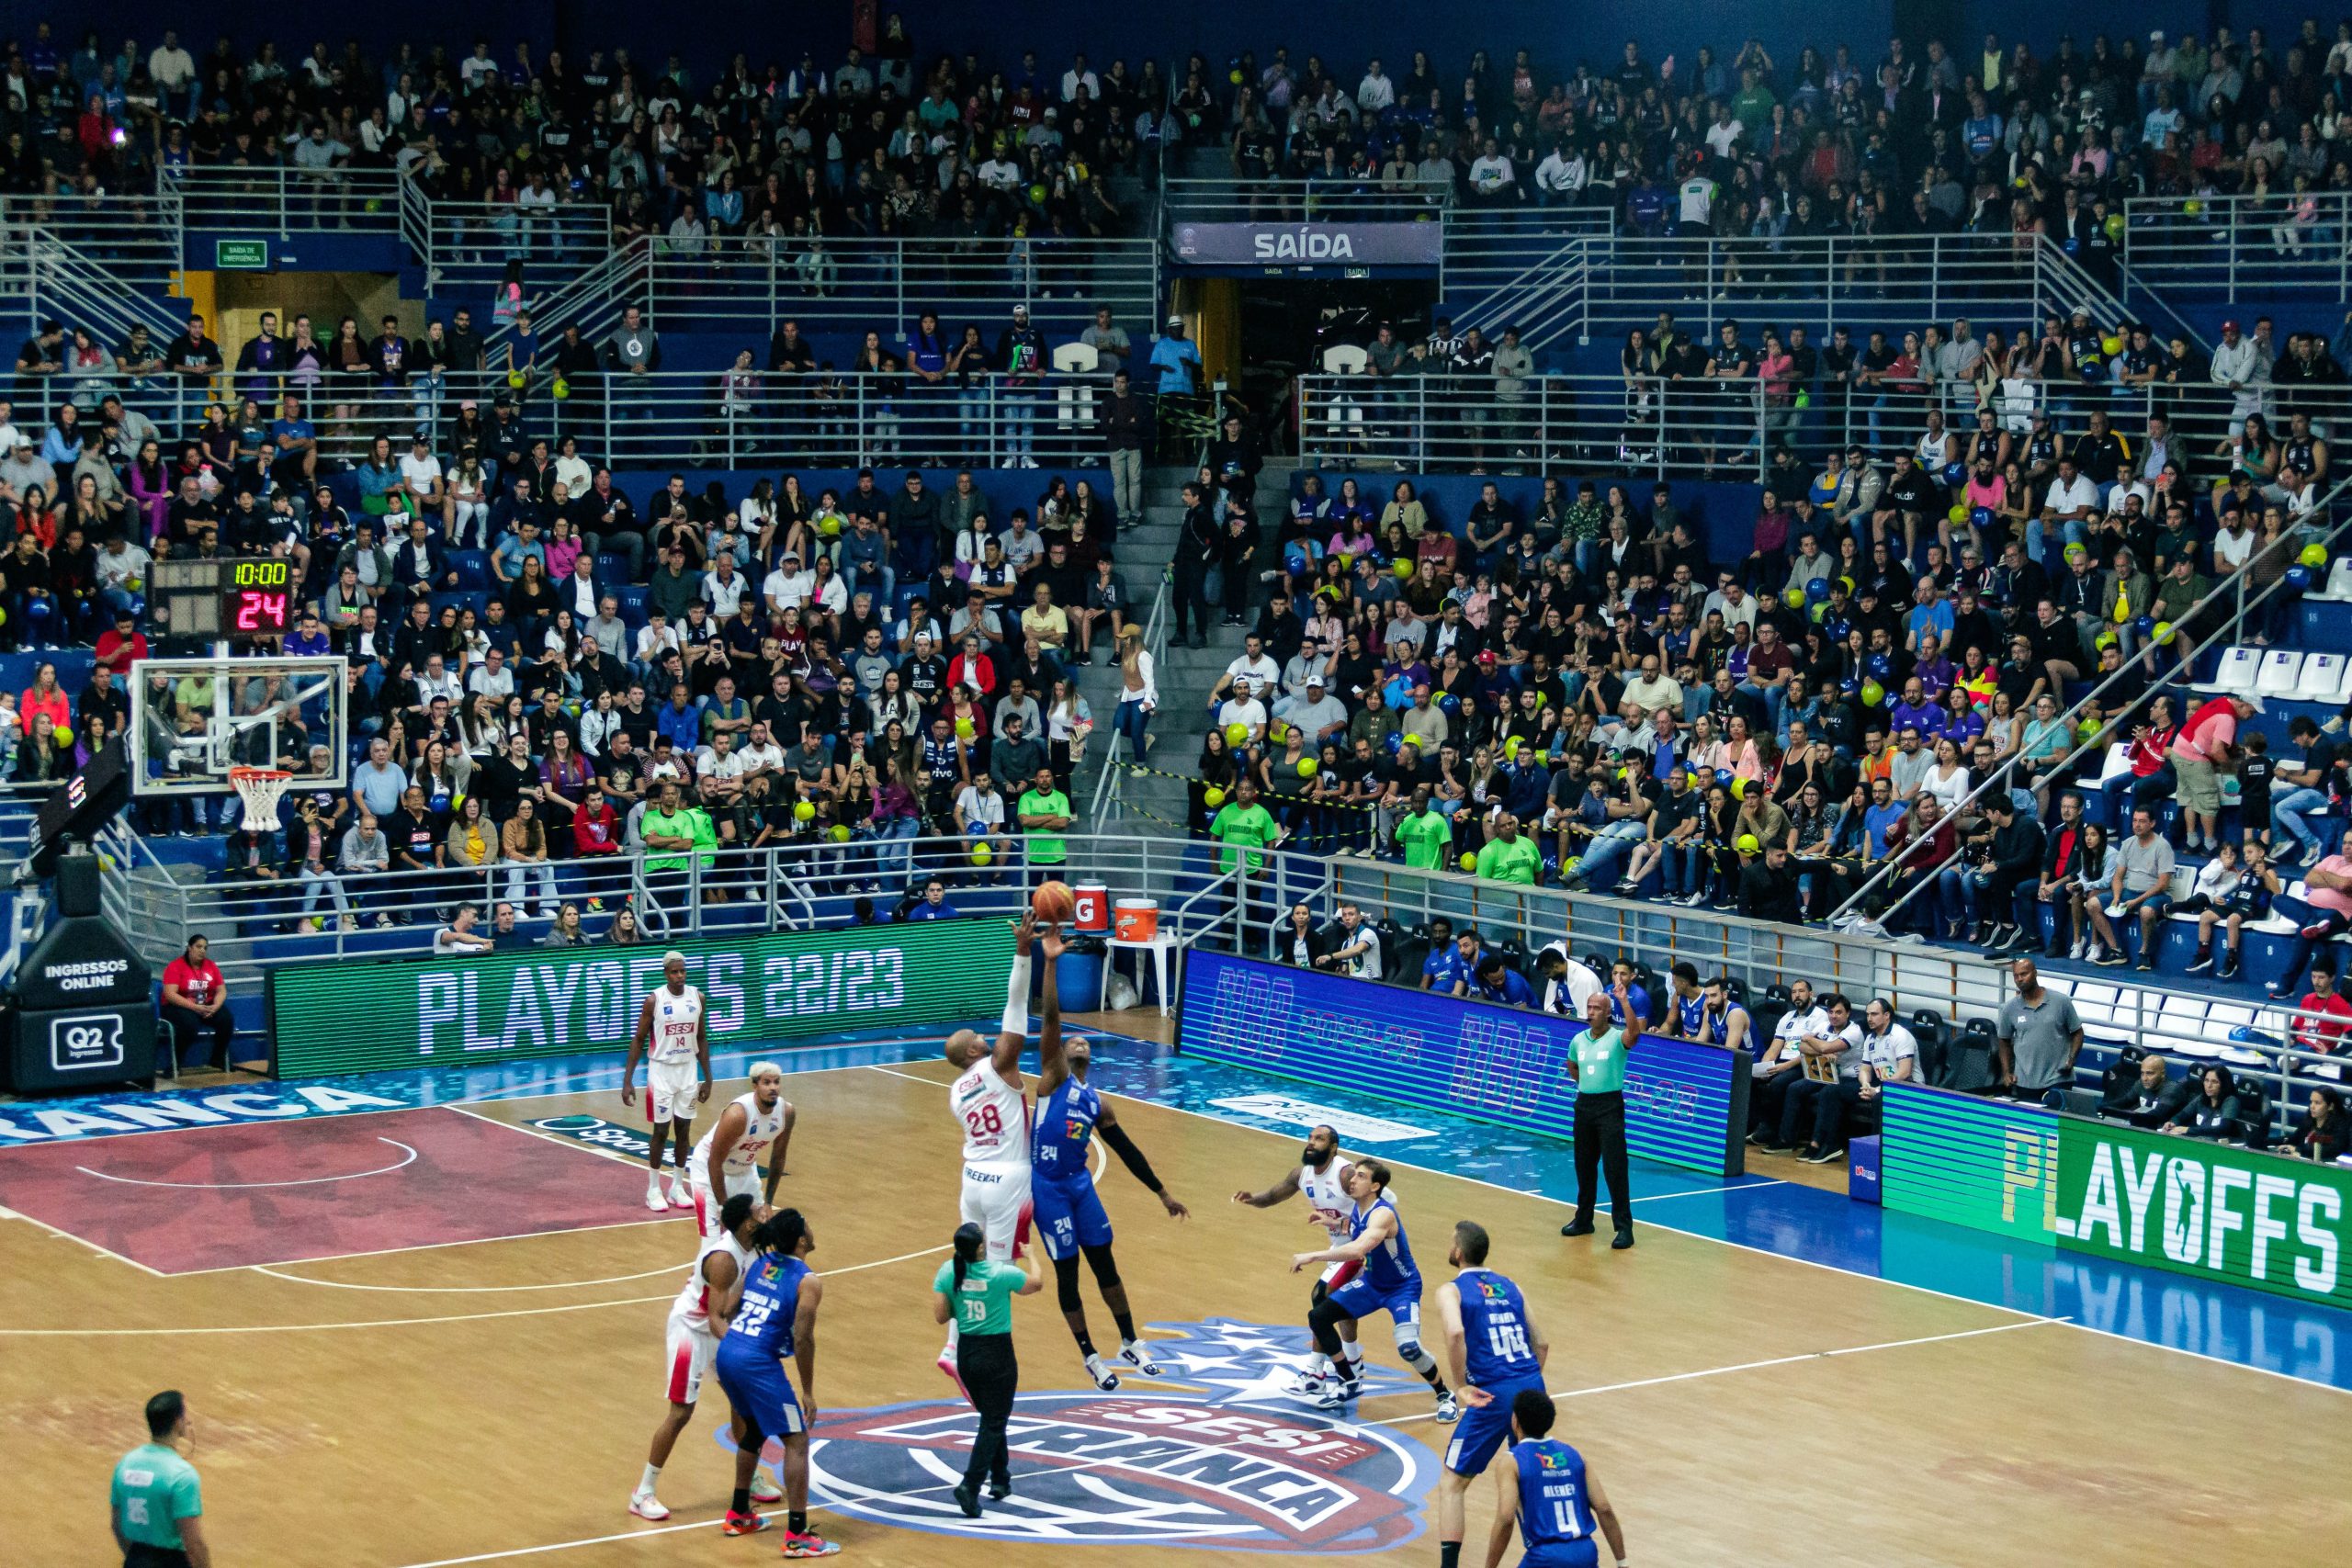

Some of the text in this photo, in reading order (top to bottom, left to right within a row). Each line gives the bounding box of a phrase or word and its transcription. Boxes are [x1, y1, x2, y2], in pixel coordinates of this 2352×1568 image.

[1255, 227, 1353, 258] SAÍDA
[235, 563, 286, 585] 10:00
[238, 591, 286, 628] 24
[2120, 806, 2130, 815] 14
[2164, 811, 2173, 820] 13
[1076, 897, 1093, 922] G
[2128, 927, 2137, 937] 11
[2171, 933, 2182, 943] 10
[2267, 945, 2273, 955] 8
[45, 960, 128, 978] INGRESSOS
[61, 975, 115, 990] ONLINE
[418, 947, 905, 1055] PLAYOFS 22/23
[67, 1027, 104, 1049] Q2
[668, 1023, 694, 1035] SESI
[676, 1036, 685, 1047] 14
[967, 1103, 1001, 1138] 28
[1041, 1145, 1057, 1161] 24
[965, 1167, 1002, 1184] FREEWAY
[2002, 1123, 2342, 1293] PLAYOFFS
[1054, 1217, 1071, 1232] 24
[1477, 1282, 1506, 1298] 123
[730, 1301, 771, 1337] 22
[1488, 1324, 1532, 1363] 44
[1102, 1407, 1351, 1456] SESI
[1536, 1451, 1568, 1469] 123
[1554, 1500, 1581, 1539] 4
